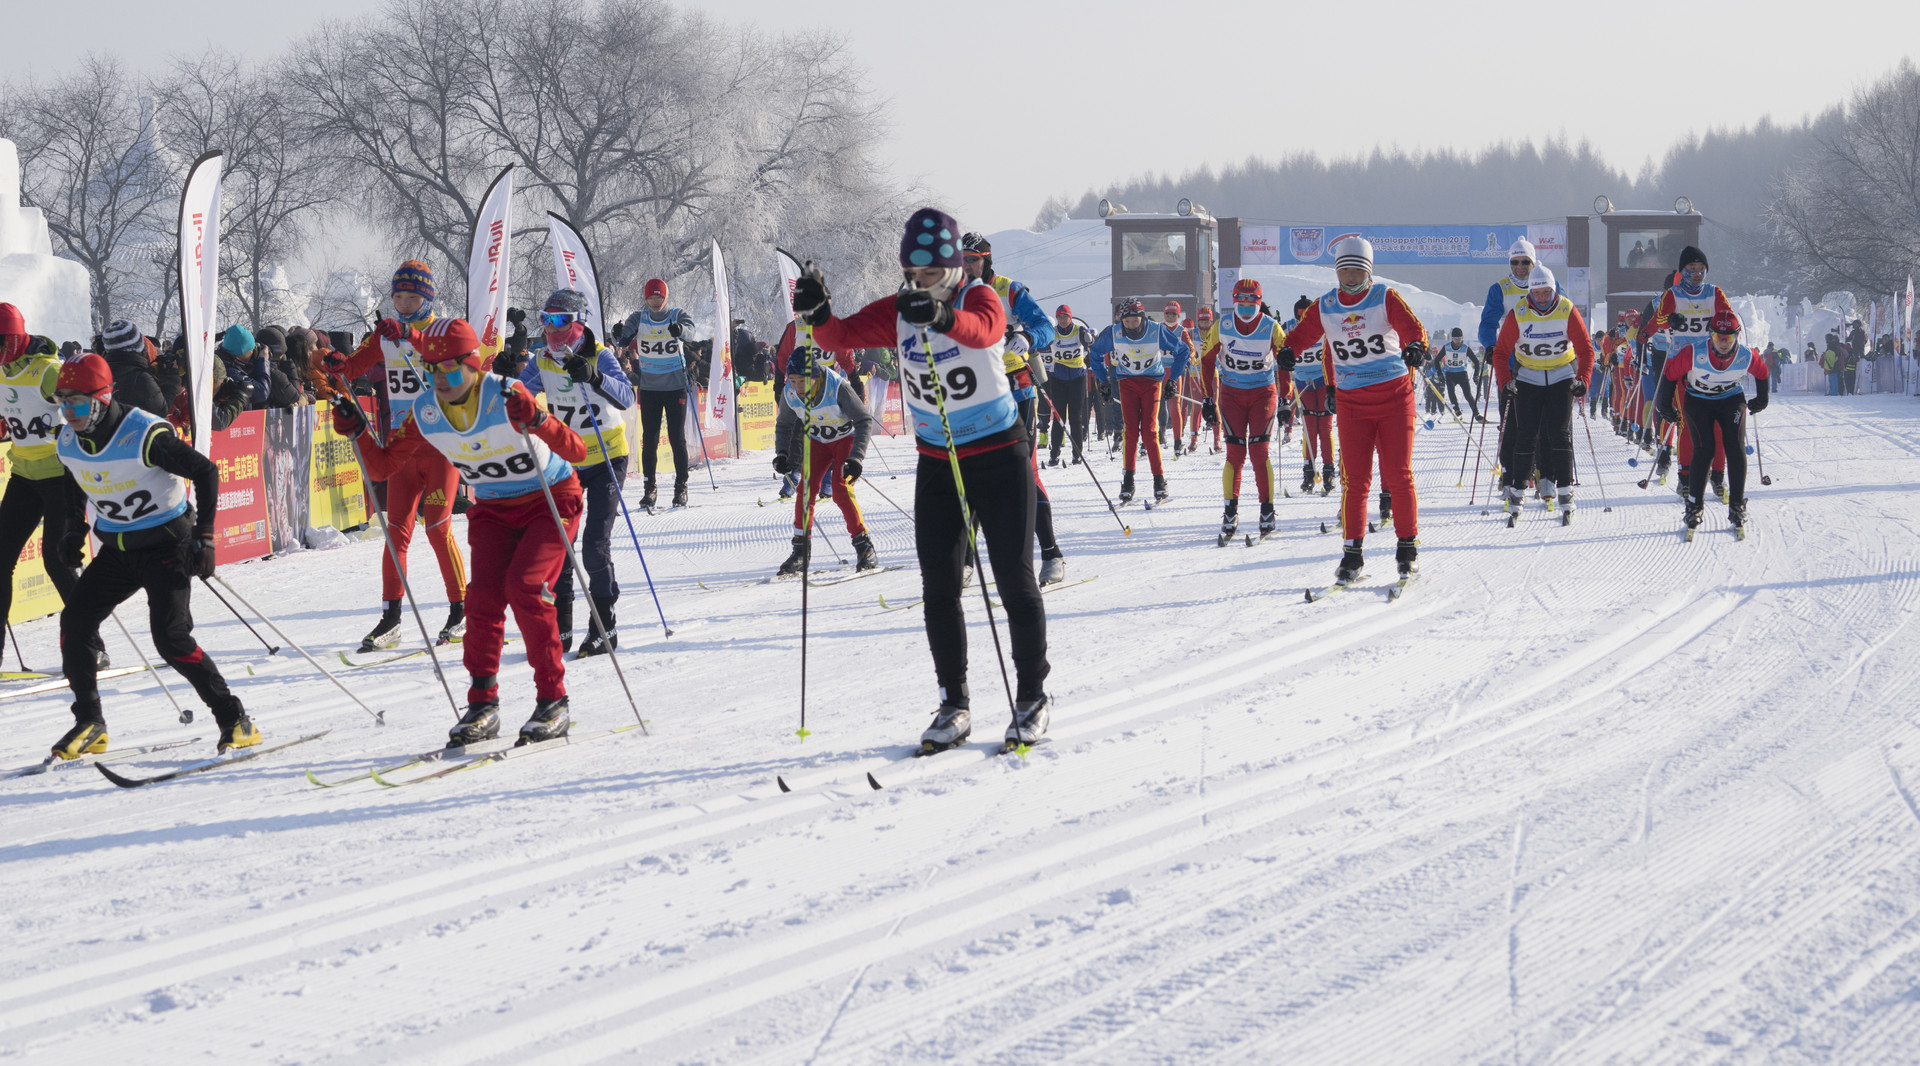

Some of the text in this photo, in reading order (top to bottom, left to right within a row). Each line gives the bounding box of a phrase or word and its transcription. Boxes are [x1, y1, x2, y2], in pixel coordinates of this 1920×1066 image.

[1368, 236, 1418, 244] Vasaloppet
[1471, 250, 1509, 258] VASALOPPE
[640, 340, 678, 355] 546
[1054, 348, 1081, 360] 462
[1333, 334, 1386, 361] 633
[1519, 340, 1569, 357] 463
[388, 370, 431, 394] 55
[904, 366, 978, 406] 659
[93, 489, 159, 522] 22
[424, 498, 449, 507] adidas
[53, 759, 85, 772] ATOMIC
